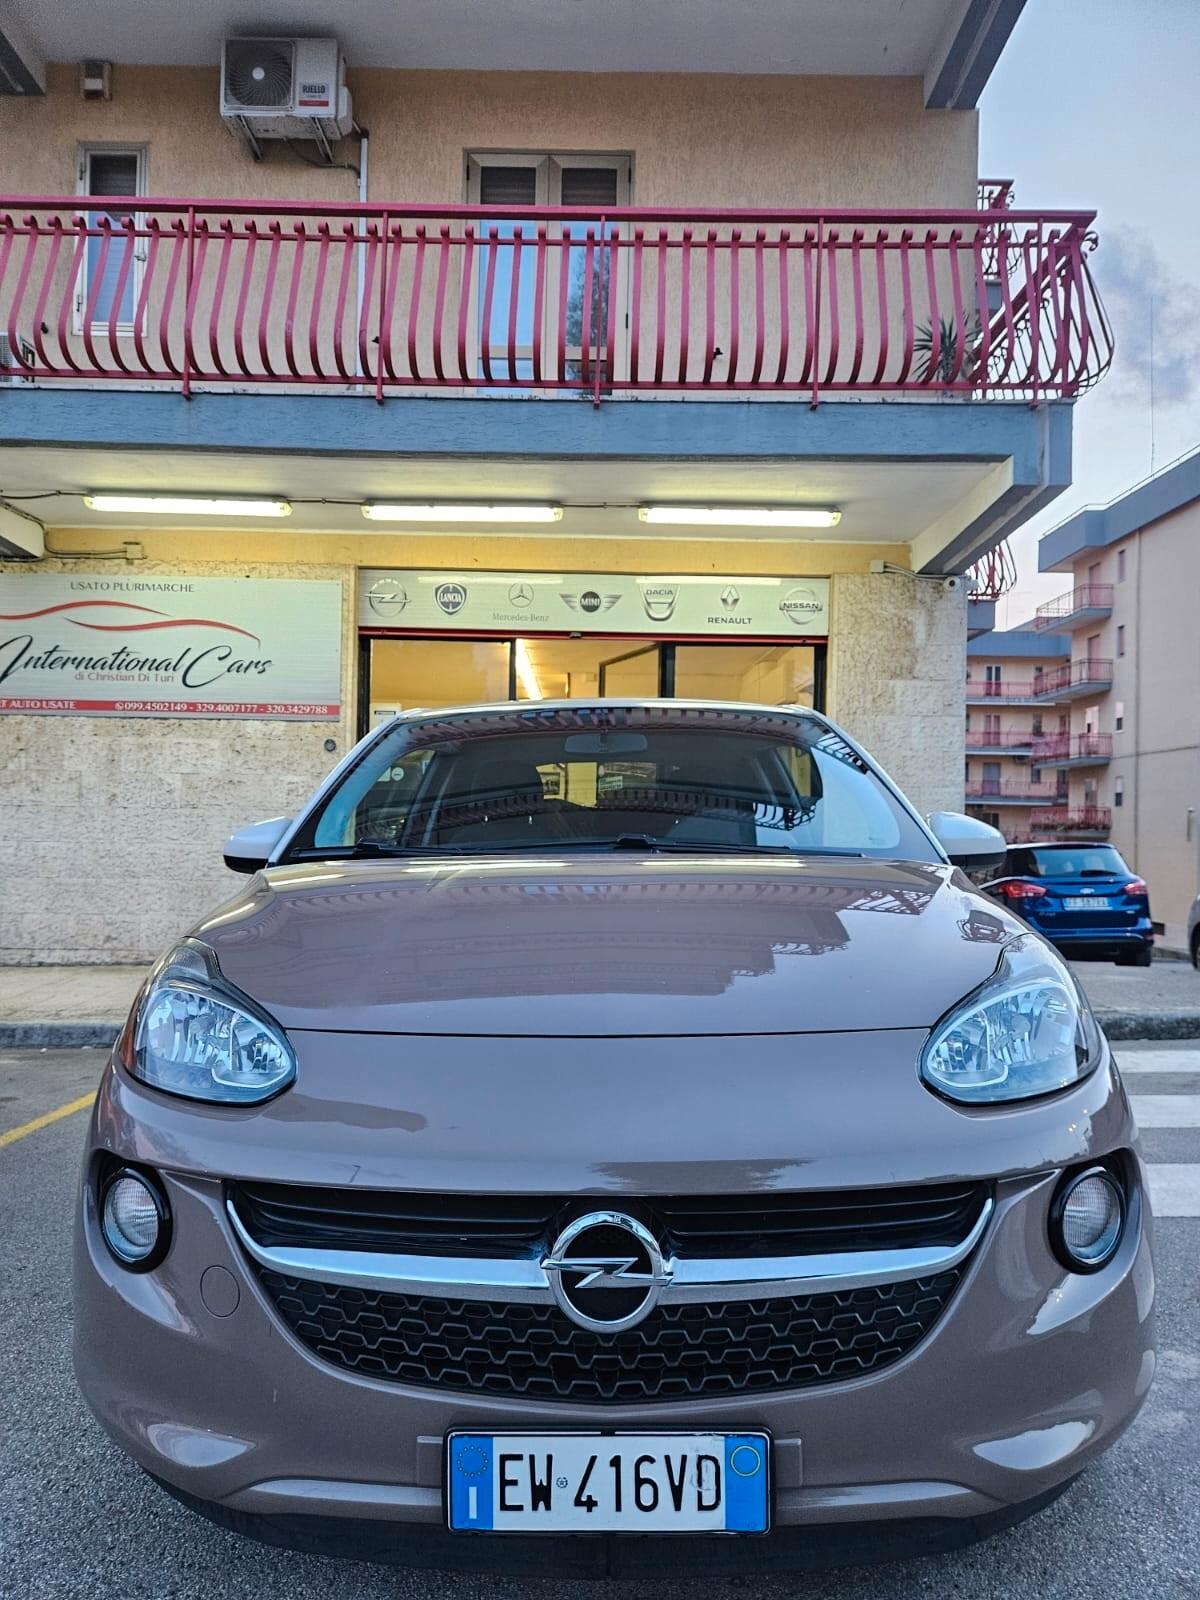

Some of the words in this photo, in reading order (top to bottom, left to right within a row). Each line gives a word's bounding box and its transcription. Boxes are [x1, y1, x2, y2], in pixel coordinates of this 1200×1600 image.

[70, 581, 110, 591] USATO
[113, 582, 195, 593] PLURIMARCHE
[645, 588, 674, 597] DACIA
[783, 601, 819, 610] NISSAN
[707, 616, 752, 625] RENAULT
[0, 635, 191, 685] International
[182, 645, 273, 688] Cars
[74, 671, 84, 681] di
[87, 671, 135, 682] Christian
[9, 700, 40, 709] AUTO
[42, 700, 77, 710] USATE
[124, 702, 188, 712] 099.4502149
[195, 703, 258, 713] 329.4007177
[266, 704, 329, 714] 320.3429788
[468, 1486, 477, 1519] I
